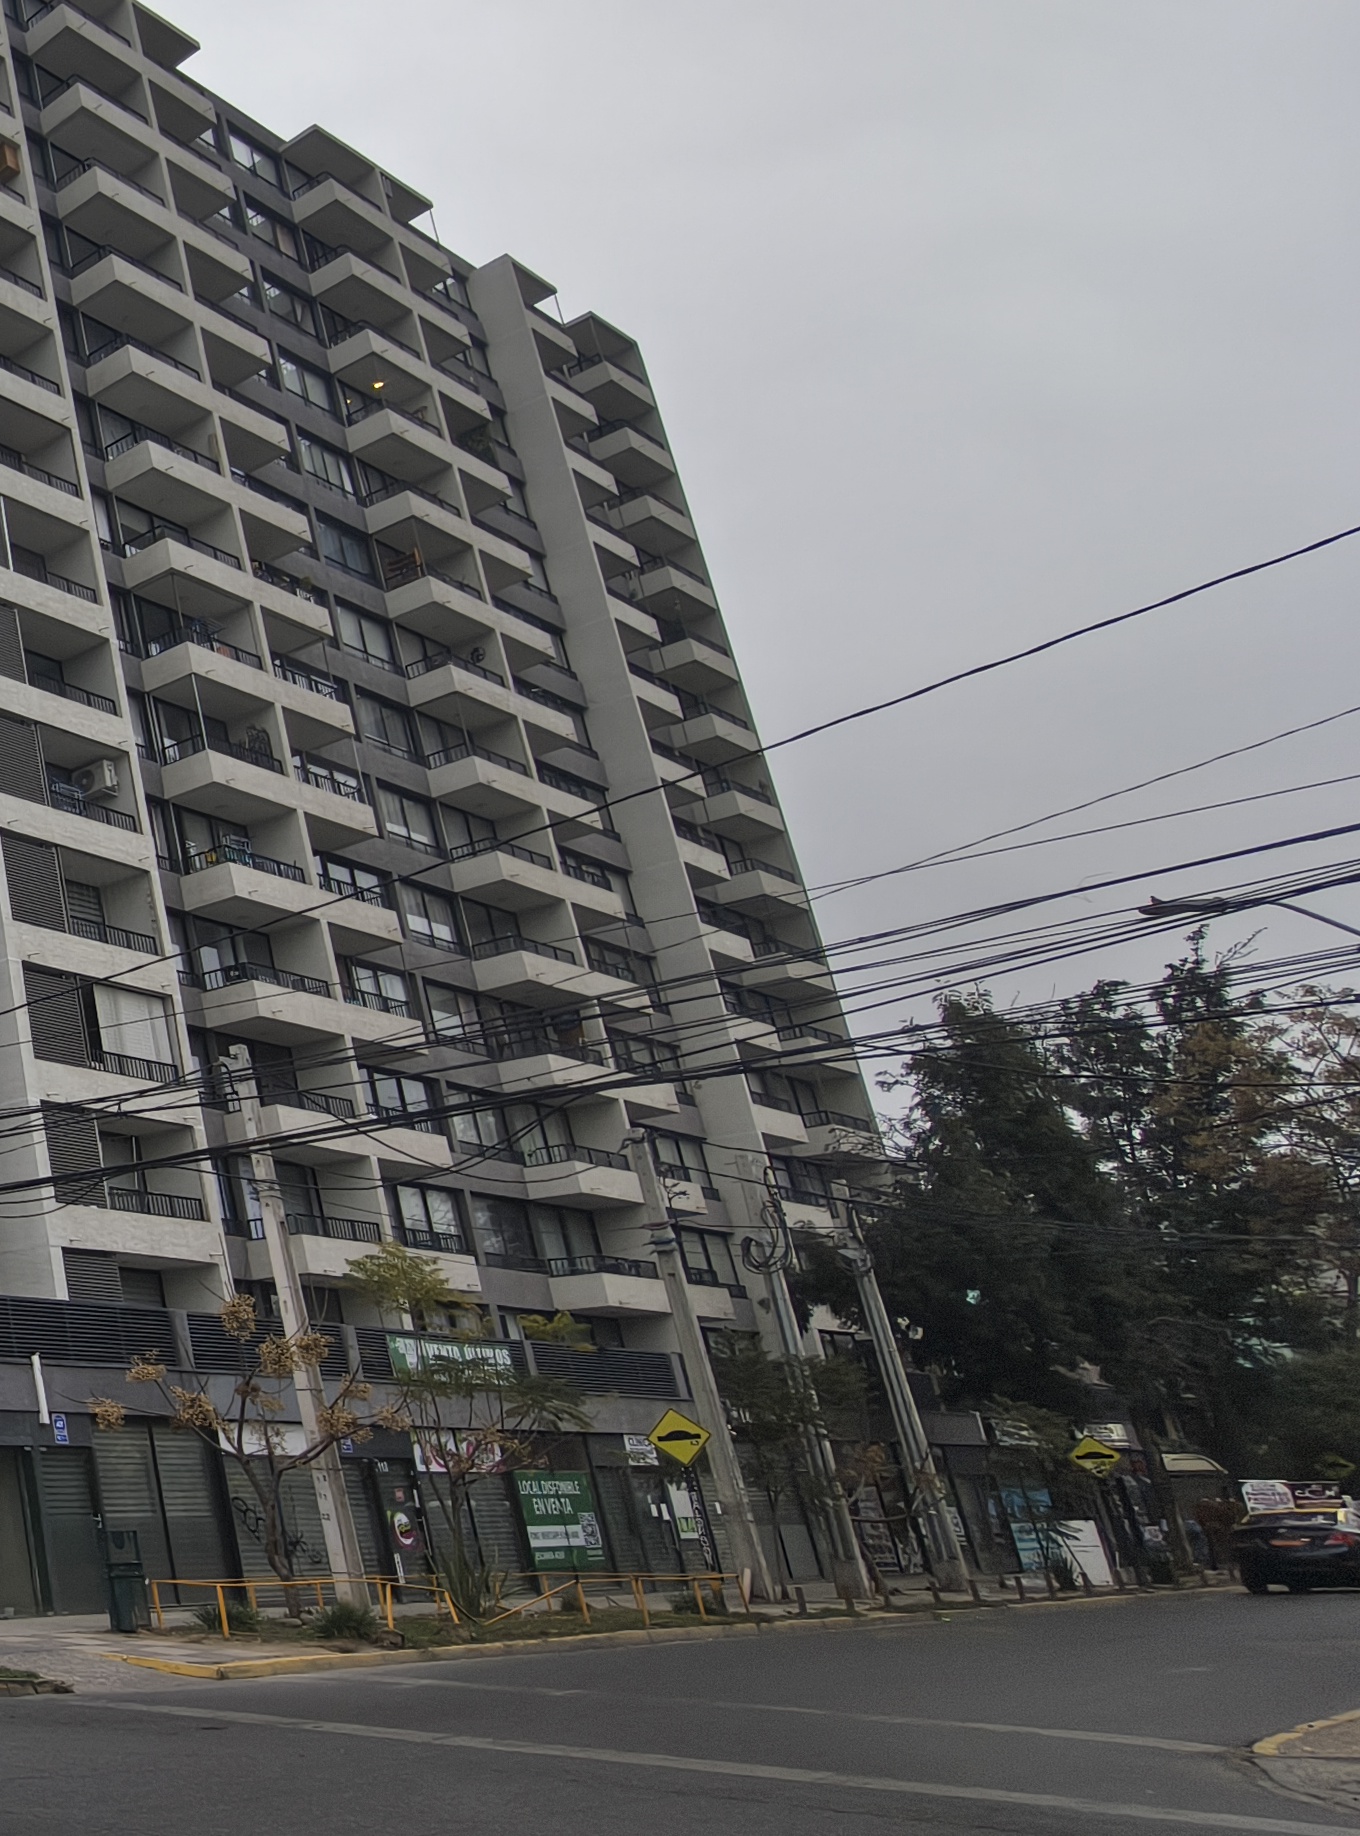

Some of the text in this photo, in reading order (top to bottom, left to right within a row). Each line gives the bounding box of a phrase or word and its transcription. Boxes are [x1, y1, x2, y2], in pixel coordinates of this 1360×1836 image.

[518, 1480, 542, 1495] LOCAL
[533, 1498, 574, 1515] EN VENTA
